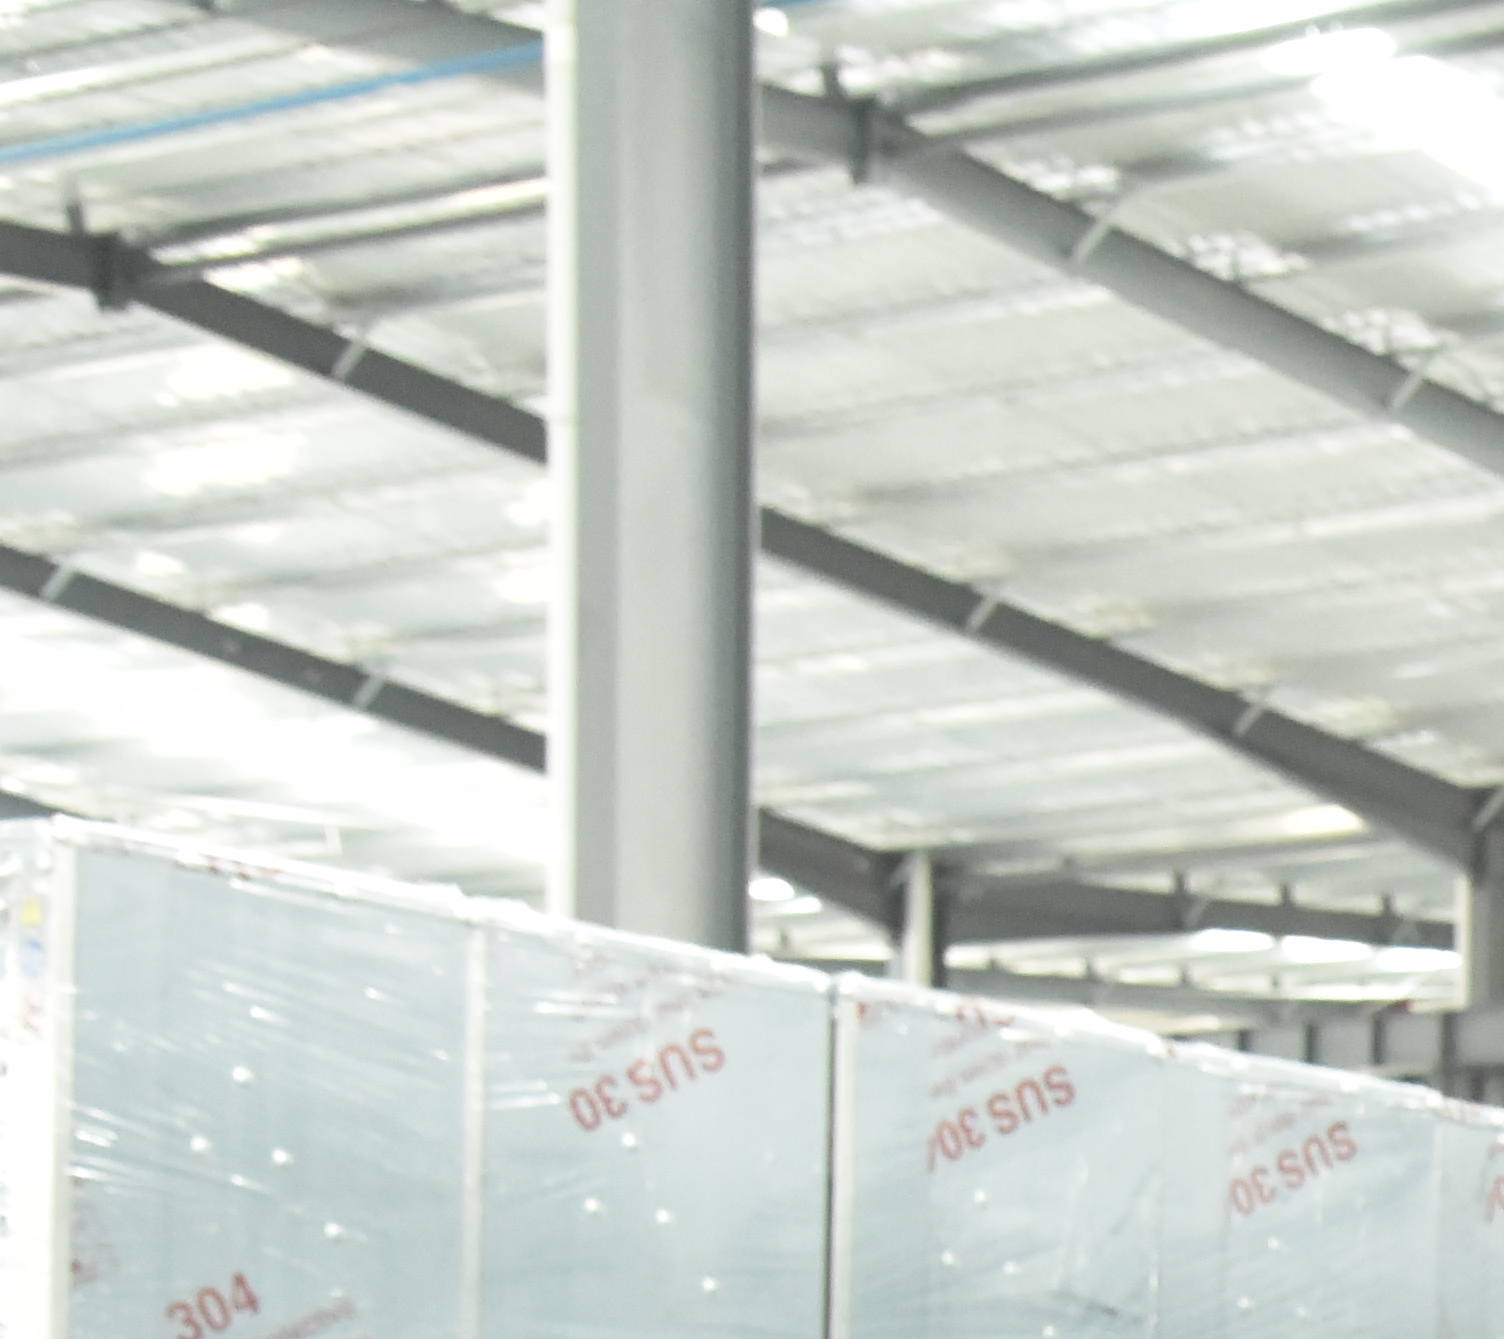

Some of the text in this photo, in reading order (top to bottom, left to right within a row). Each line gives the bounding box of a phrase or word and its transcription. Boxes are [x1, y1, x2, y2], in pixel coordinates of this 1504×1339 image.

[629, 1028, 725, 1105] SUS
[993, 1066, 1076, 1135] SUS
[1278, 1122, 1359, 1191] SUS
